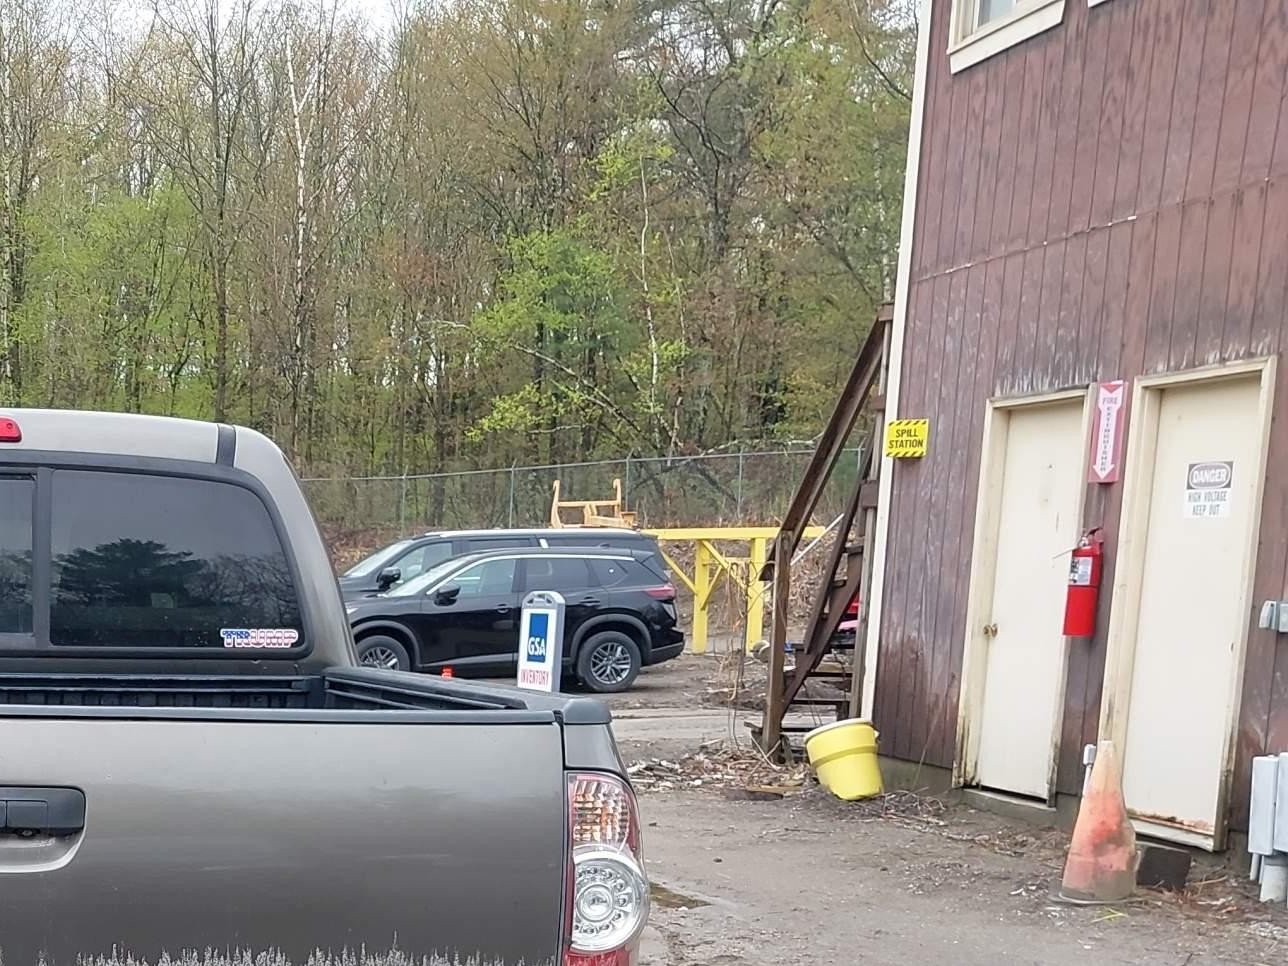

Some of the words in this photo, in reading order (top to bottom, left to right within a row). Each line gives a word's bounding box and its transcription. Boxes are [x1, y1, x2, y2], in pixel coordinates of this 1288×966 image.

[1102, 397, 1119, 405] FIRE
[895, 428, 919, 438] SPILL
[888, 439, 924, 449] STATION
[1192, 469, 1227, 483] DANGER
[220, 628, 299, 648] TRUMP
[528, 636, 546, 656] GSA
[520, 668, 549, 686] INVENTORY
